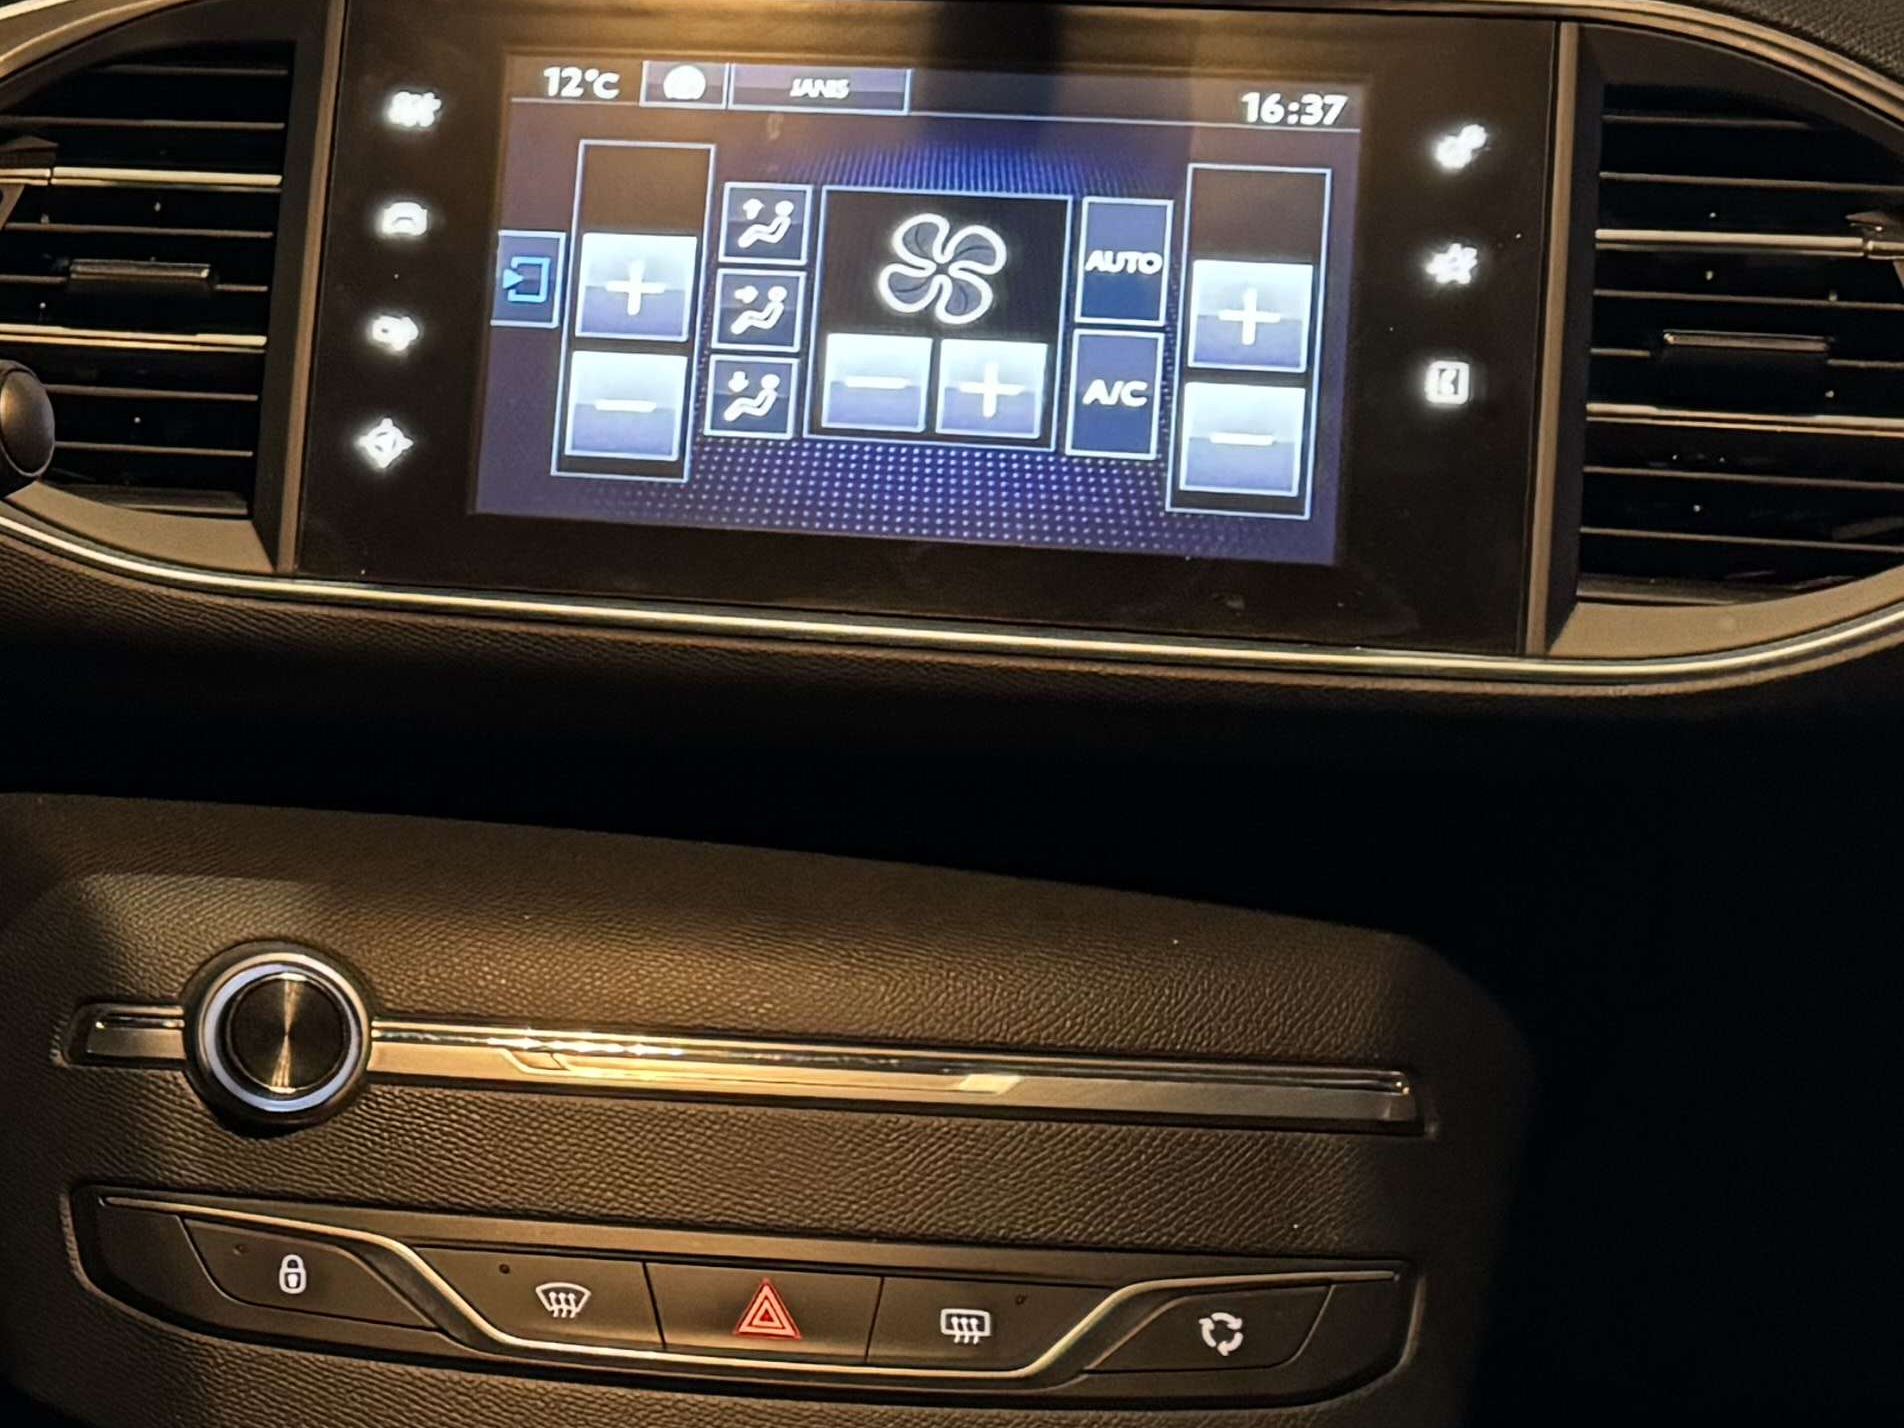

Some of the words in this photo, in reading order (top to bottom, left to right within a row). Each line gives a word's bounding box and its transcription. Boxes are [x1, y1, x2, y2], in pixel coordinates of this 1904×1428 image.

[543, 66, 620, 99] 12°C
[1241, 92, 1348, 125] 16:37
[1085, 250, 1163, 275] AUTO
[1082, 379, 1148, 407] A/C
